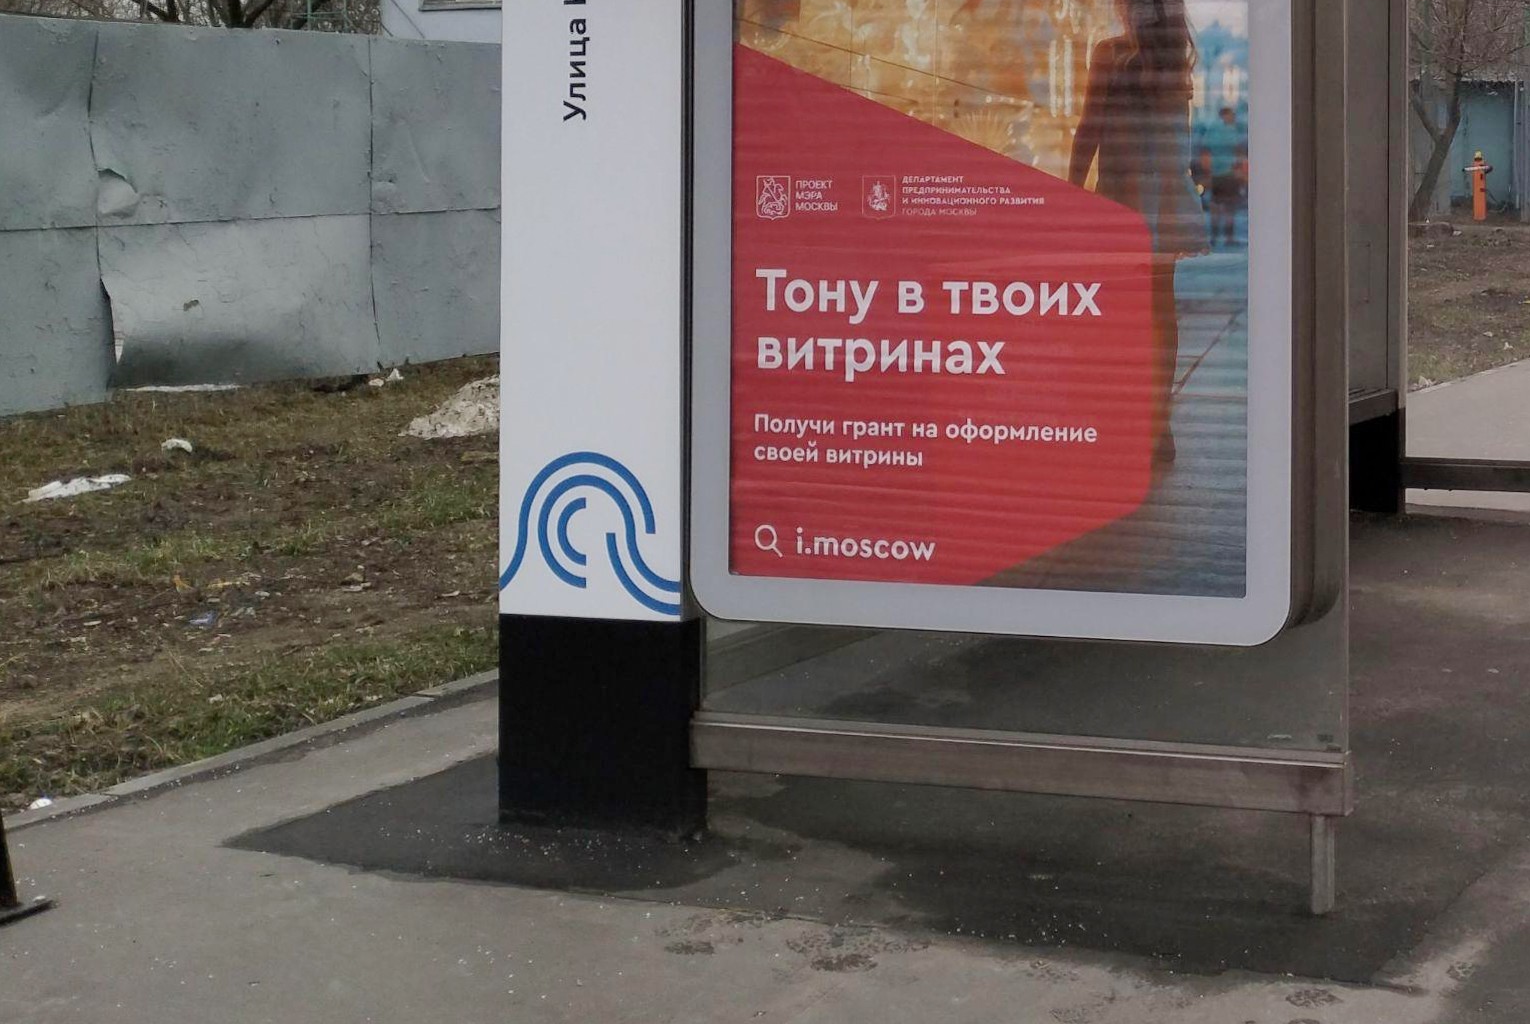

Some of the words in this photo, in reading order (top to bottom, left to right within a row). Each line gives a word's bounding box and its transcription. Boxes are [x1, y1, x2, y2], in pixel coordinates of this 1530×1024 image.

[563, 18, 590, 122] Улица
[902, 175, 964, 184] ДЕПАРТАМЕНТ
[795, 180, 833, 190] ПРОЕКТ
[902, 186, 1011, 195] ПРЕДПРИНИМАТЕЛЬСТВА
[795, 191, 823, 201] МЭРА
[902, 197, 909, 205] И
[911, 197, 997, 205] ИННОВАЦИОННОГО
[999, 197, 1045, 205] РАЗВИТИЯ
[795, 202, 838, 212] МОСКВЫ
[902, 207, 936, 216] ГОРОДА
[938, 208, 977, 216] МОСКВЫ
[756, 269, 879, 325] Тону
[898, 280, 925, 314] в
[942, 281, 1102, 317] твоих
[757, 337, 1006, 382] витринах
[754, 413, 835, 439] Получи
[842, 420, 905, 440] грант
[912, 422, 939, 439] на
[945, 418, 1098, 444] оформление
[754, 440, 819, 463] своей
[826, 447, 923, 467] витрины
[796, 527, 936, 561] i.moscow
